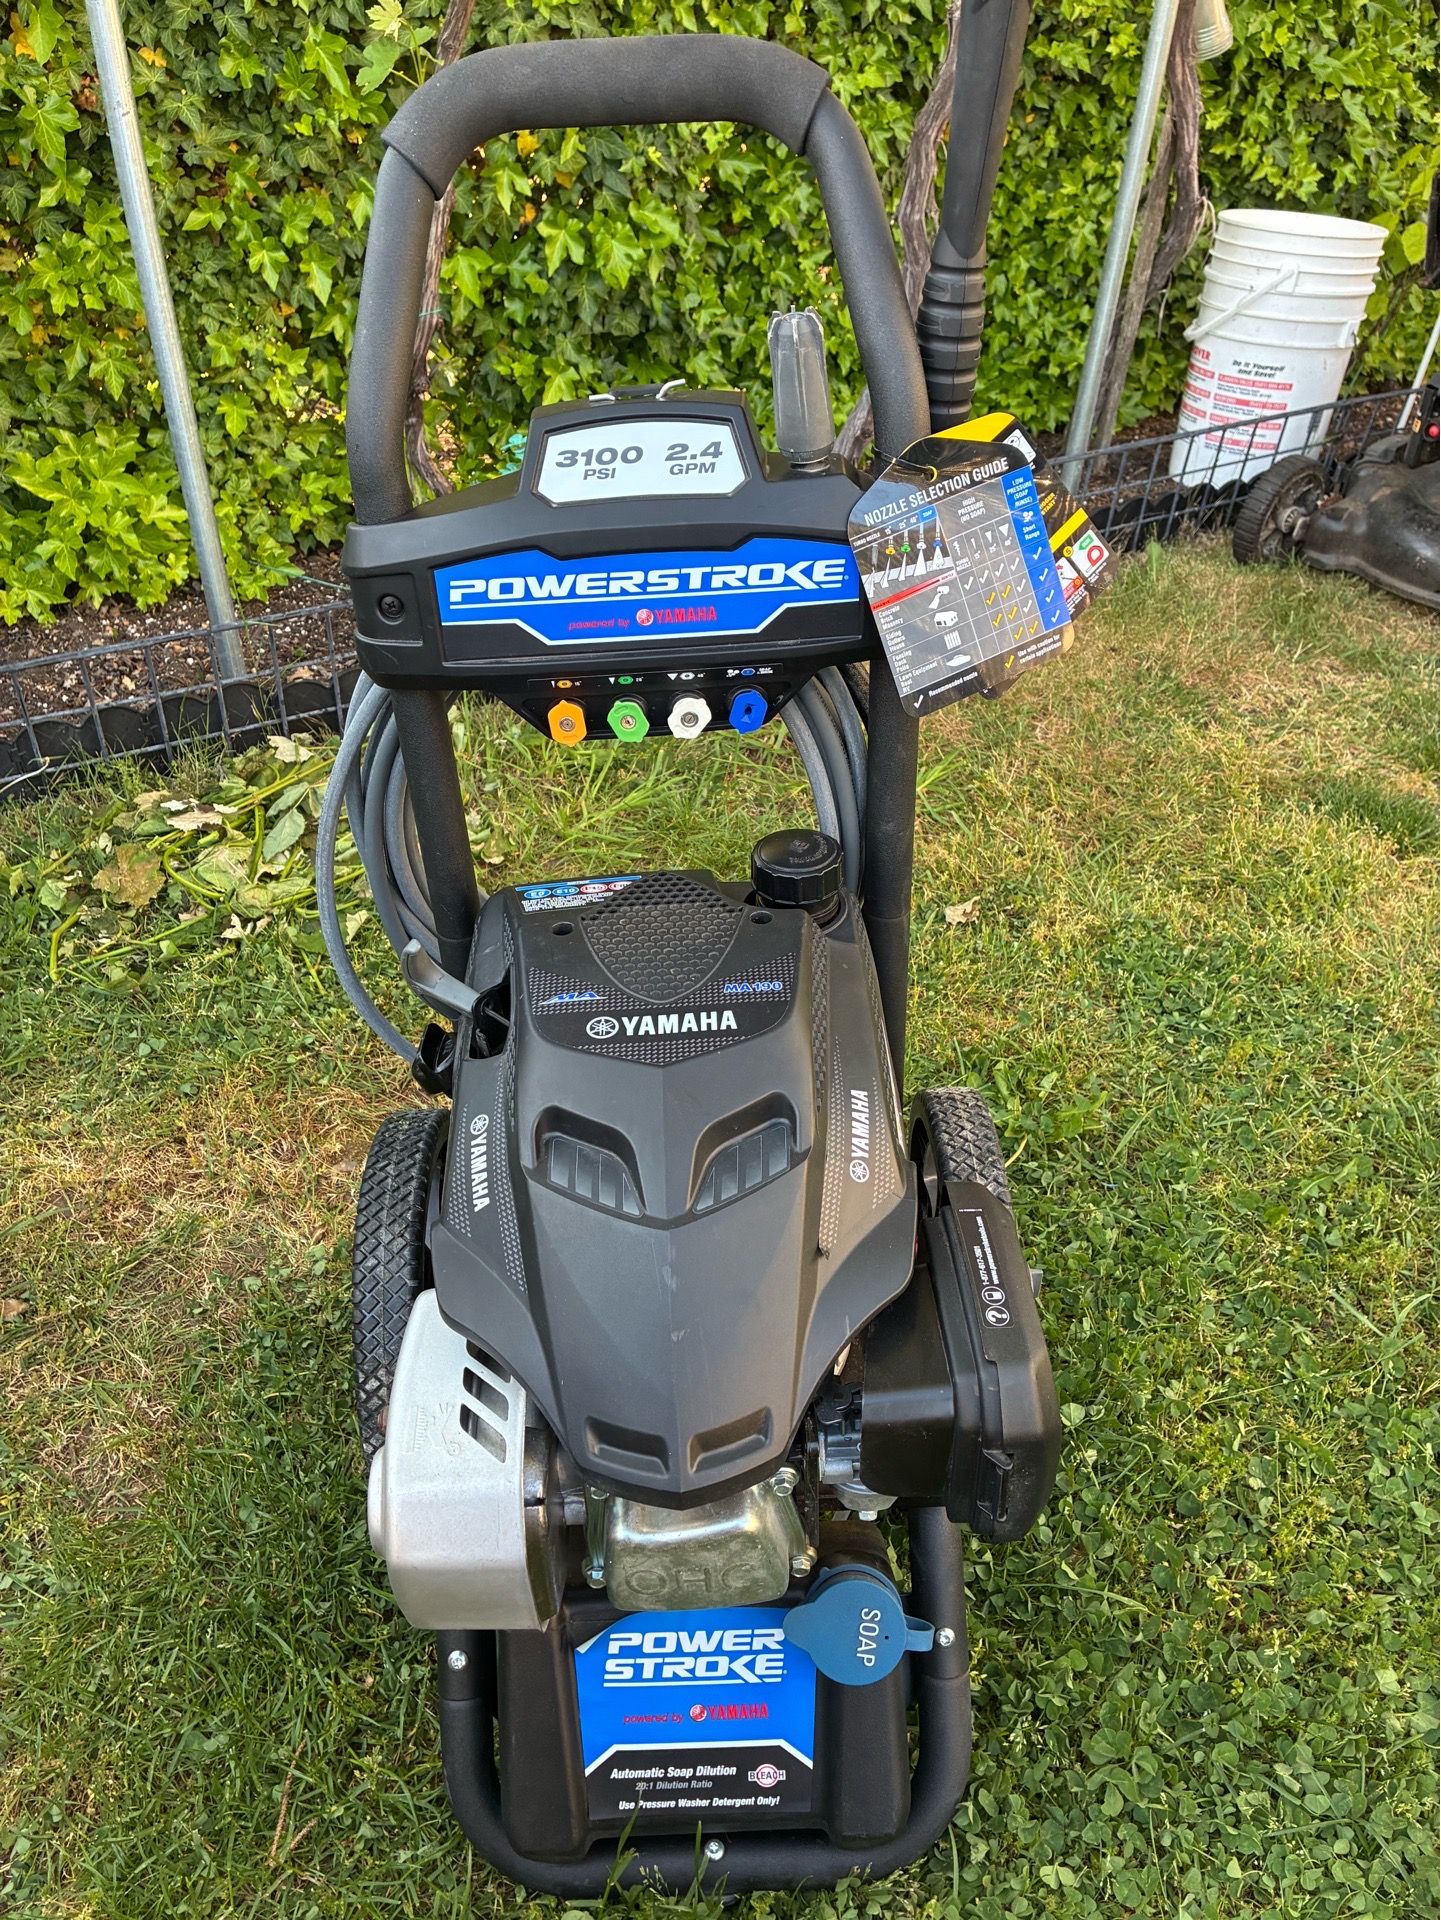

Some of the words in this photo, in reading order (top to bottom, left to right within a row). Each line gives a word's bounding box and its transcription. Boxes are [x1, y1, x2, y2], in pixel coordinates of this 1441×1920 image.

[555, 445, 644, 468] 3100
[664, 441, 723, 462] 2.4
[583, 467, 617, 480] PSI
[669, 462, 716, 476] GPM
[1006, 480, 1033, 496] PRESSURE
[1012, 476, 1024, 486] LOW
[864, 498, 909, 527] NOZZLE
[908, 473, 971, 508] SELECTION
[972, 457, 1009, 482] GUIDE
[1013, 489, 1029, 501] (SOAP
[957, 500, 984, 516] PRESSURE
[961, 496, 976, 507] HIGH
[1022, 523, 1036, 534] Short
[1024, 530, 1040, 541] Range
[853, 537, 866, 547] TURBO
[449, 558, 846, 602] POWERSTROKE
[568, 618, 615, 631] powered
[617, 618, 630, 631] by
[655, 606, 718, 625] YAMAHA
[878, 605, 900, 618] Concrete
[898, 672, 913, 682] Lawn
[912, 661, 938, 677] Equipment
[928, 676, 963, 697] Recommended
[559, 886, 576, 894] E10
[621, 1010, 738, 1036] YAMAHA
[850, 1089, 869, 1158] YAMAHA
[470, 1132, 490, 1212] YAMAHA
[625, 1562, 760, 1596] OHC
[607, 1628, 785, 1654] POWER
[856, 1608, 881, 1668] SOAP
[603, 1653, 785, 1683] STROKE
[623, 1713, 669, 1725] powered
[671, 1712, 683, 1724] by
[708, 1703, 769, 1721] YAMAHA
[610, 1768, 665, 1779] Automatic
[666, 1766, 693, 1779] Soap
[695, 1765, 737, 1777] Dilution
[748, 1770, 786, 1782] BLEACH
[635, 1782, 654, 1791] 20:1
[656, 1781, 689, 1790] Dilution
[690, 1780, 713, 1789] Ratio
[618, 1800, 635, 1810] Use
[638, 1799, 676, 1809] Pressure
[677, 1798, 710, 1808] Washer
[712, 1797, 755, 1808] Detergent
[757, 1796, 780, 1807] Only!
